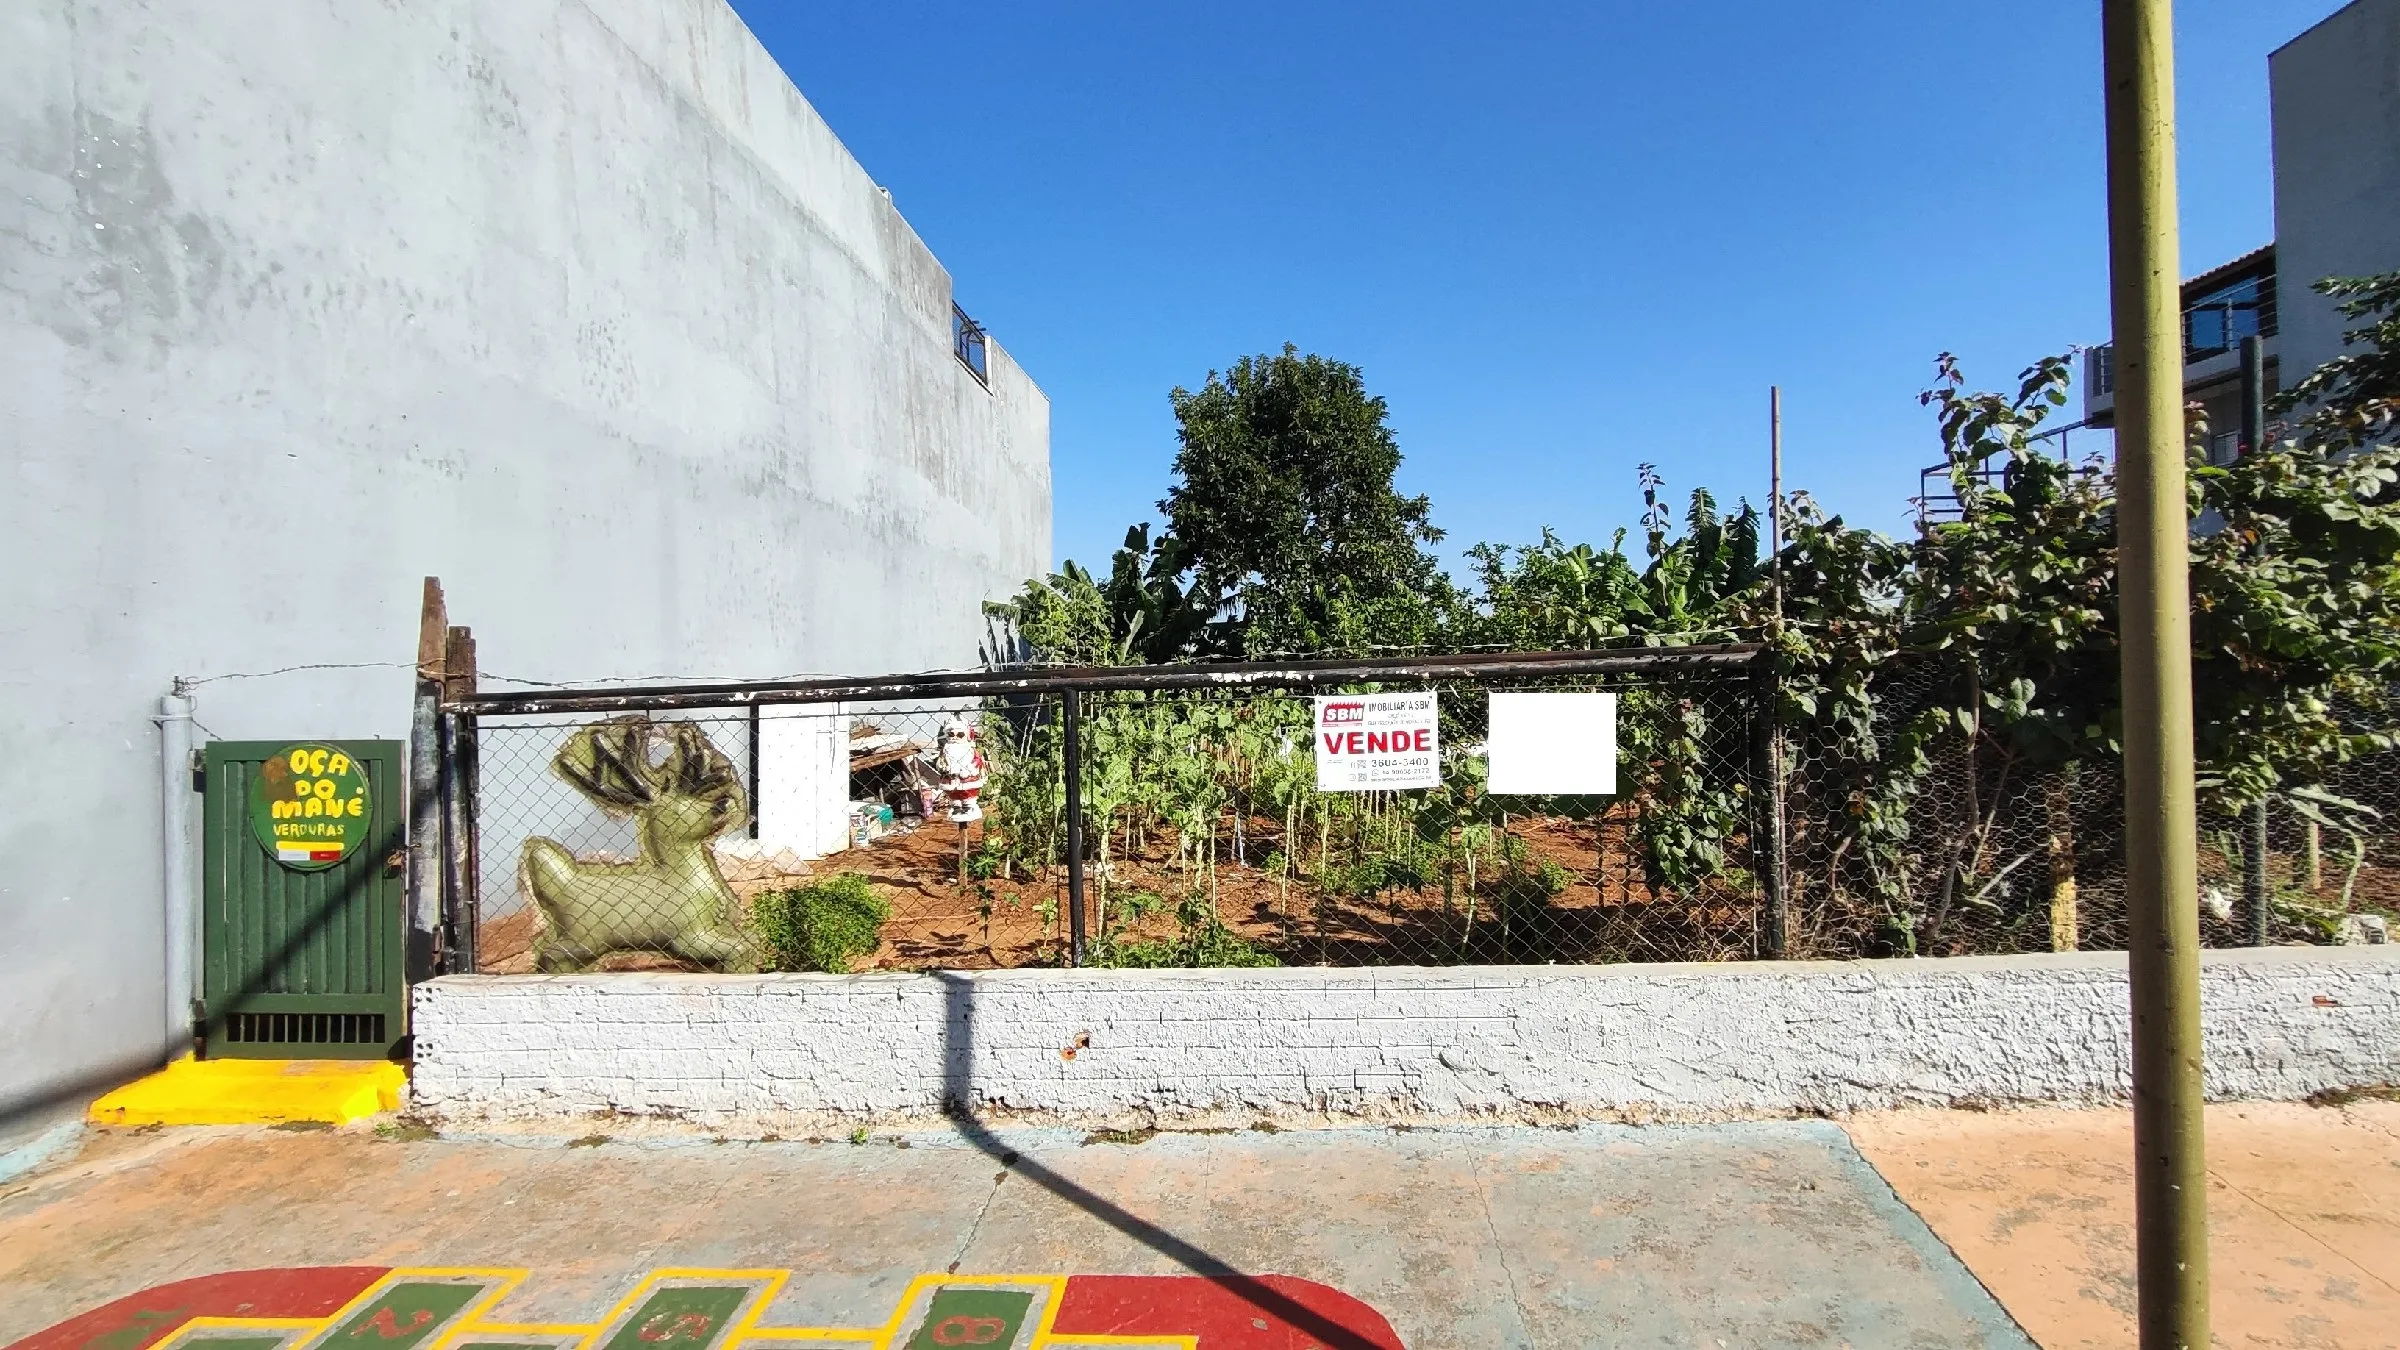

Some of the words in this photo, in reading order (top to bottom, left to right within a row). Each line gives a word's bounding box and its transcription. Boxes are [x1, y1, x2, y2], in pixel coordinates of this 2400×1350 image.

[1326, 708, 1363, 721] SBM
[1323, 729, 1432, 754] VENDE
[290, 749, 350, 777] OÇA
[295, 779, 336, 800] DO
[273, 823, 345, 837] VERDURAS
[932, 1314, 1006, 1346] 8
